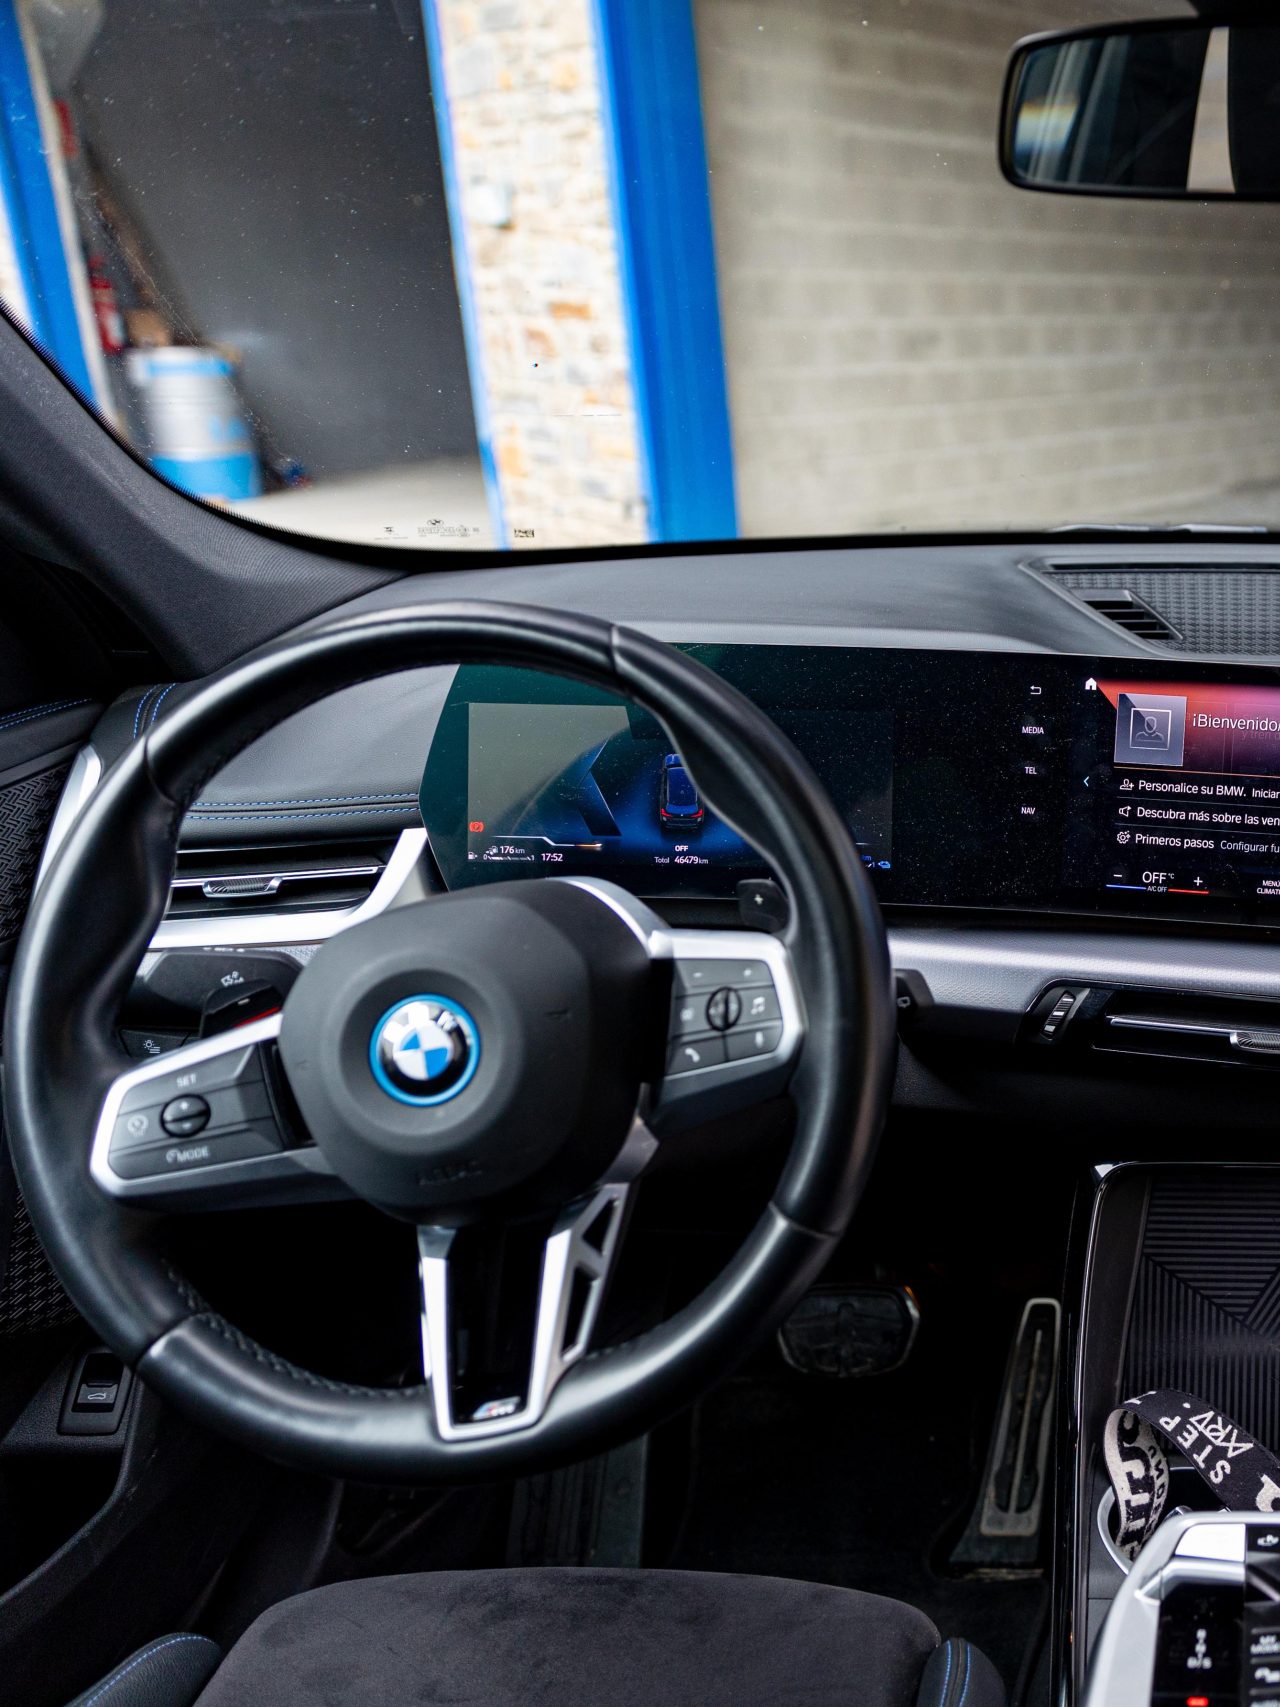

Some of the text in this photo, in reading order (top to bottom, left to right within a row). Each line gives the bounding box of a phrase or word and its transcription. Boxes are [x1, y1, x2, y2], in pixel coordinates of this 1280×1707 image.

[1021, 726, 1045, 735] MEDIA
[1025, 766, 1038, 775] TEL
[1138, 780, 1246, 797] Personalice su BMW.
[1252, 788, 1279, 799] Iniciar
[1021, 806, 1036, 815] NAV
[1136, 806, 1186, 820] Descubra
[1188, 810, 1210, 822] más
[1212, 812, 1242, 824] sobre
[1244, 813, 1260, 825] las
[675, 844, 689, 852] OFF
[1135, 833, 1182, 847] Primeros
[1183, 838, 1215, 850] pasos
[1220, 840, 1268, 853] Configurar
[500, 845, 515, 854] 176
[541, 853, 563, 862] 17:52
[654, 856, 670, 864] Total
[674, 856, 698, 864] 46479
[1142, 871, 1168, 884] OFF
[1262, 879, 1280, 888] MENÚ
[176, 1073, 197, 1088] SET
[177, 1146, 210, 1162] MODE
[1158, 1415, 1231, 1485] STEP
